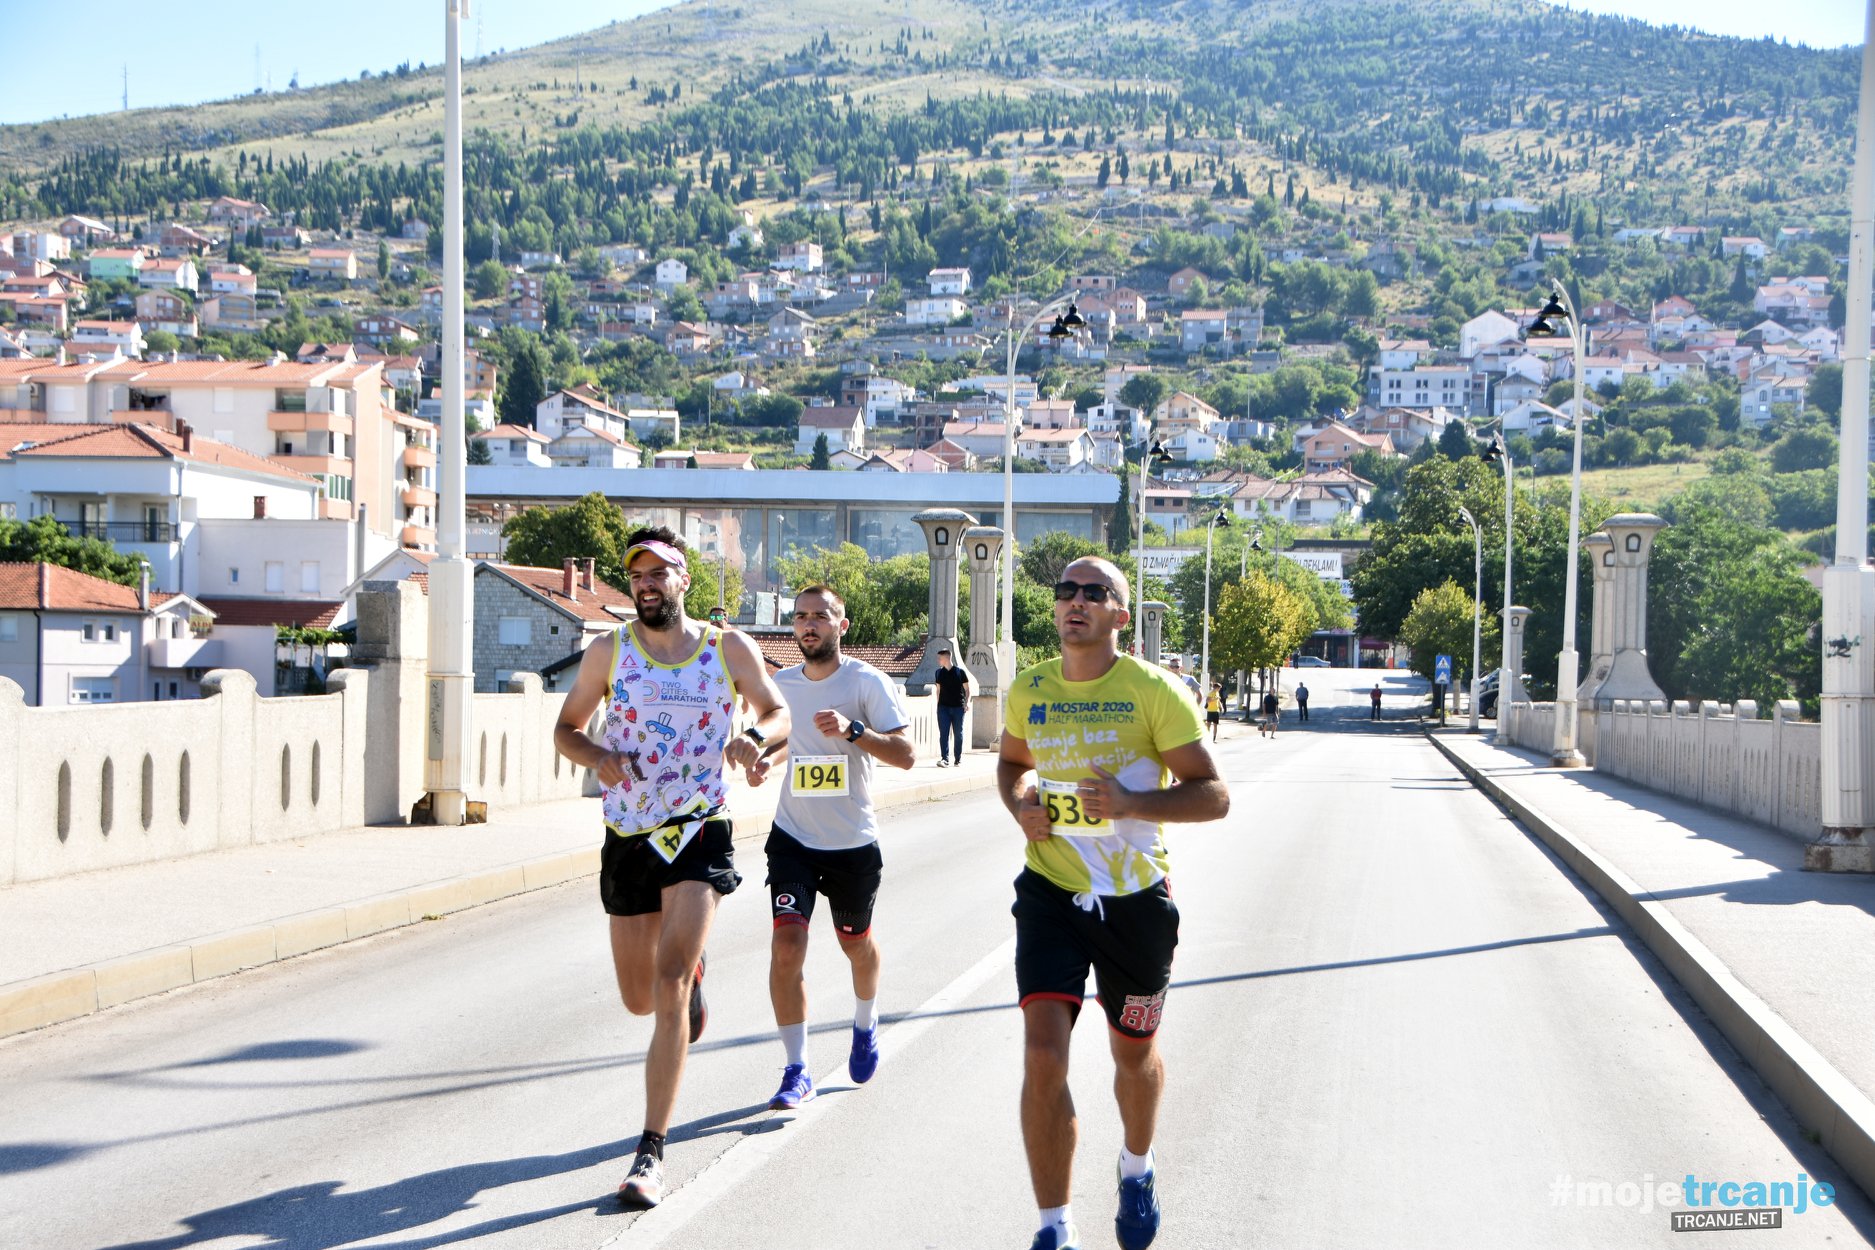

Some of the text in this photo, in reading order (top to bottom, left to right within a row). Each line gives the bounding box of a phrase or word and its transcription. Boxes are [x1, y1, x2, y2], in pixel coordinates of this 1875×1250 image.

[662, 681, 681, 689] TWO
[661, 687, 689, 696] CITIES
[661, 694, 709, 704] MARATHON
[1050, 702, 1134, 714] MOSTAR 2020
[1049, 713, 1134, 725] HALF MARATHON
[1083, 726, 1118, 744] bez
[798, 765, 842, 788] 194
[1119, 999, 1162, 1031] 86
